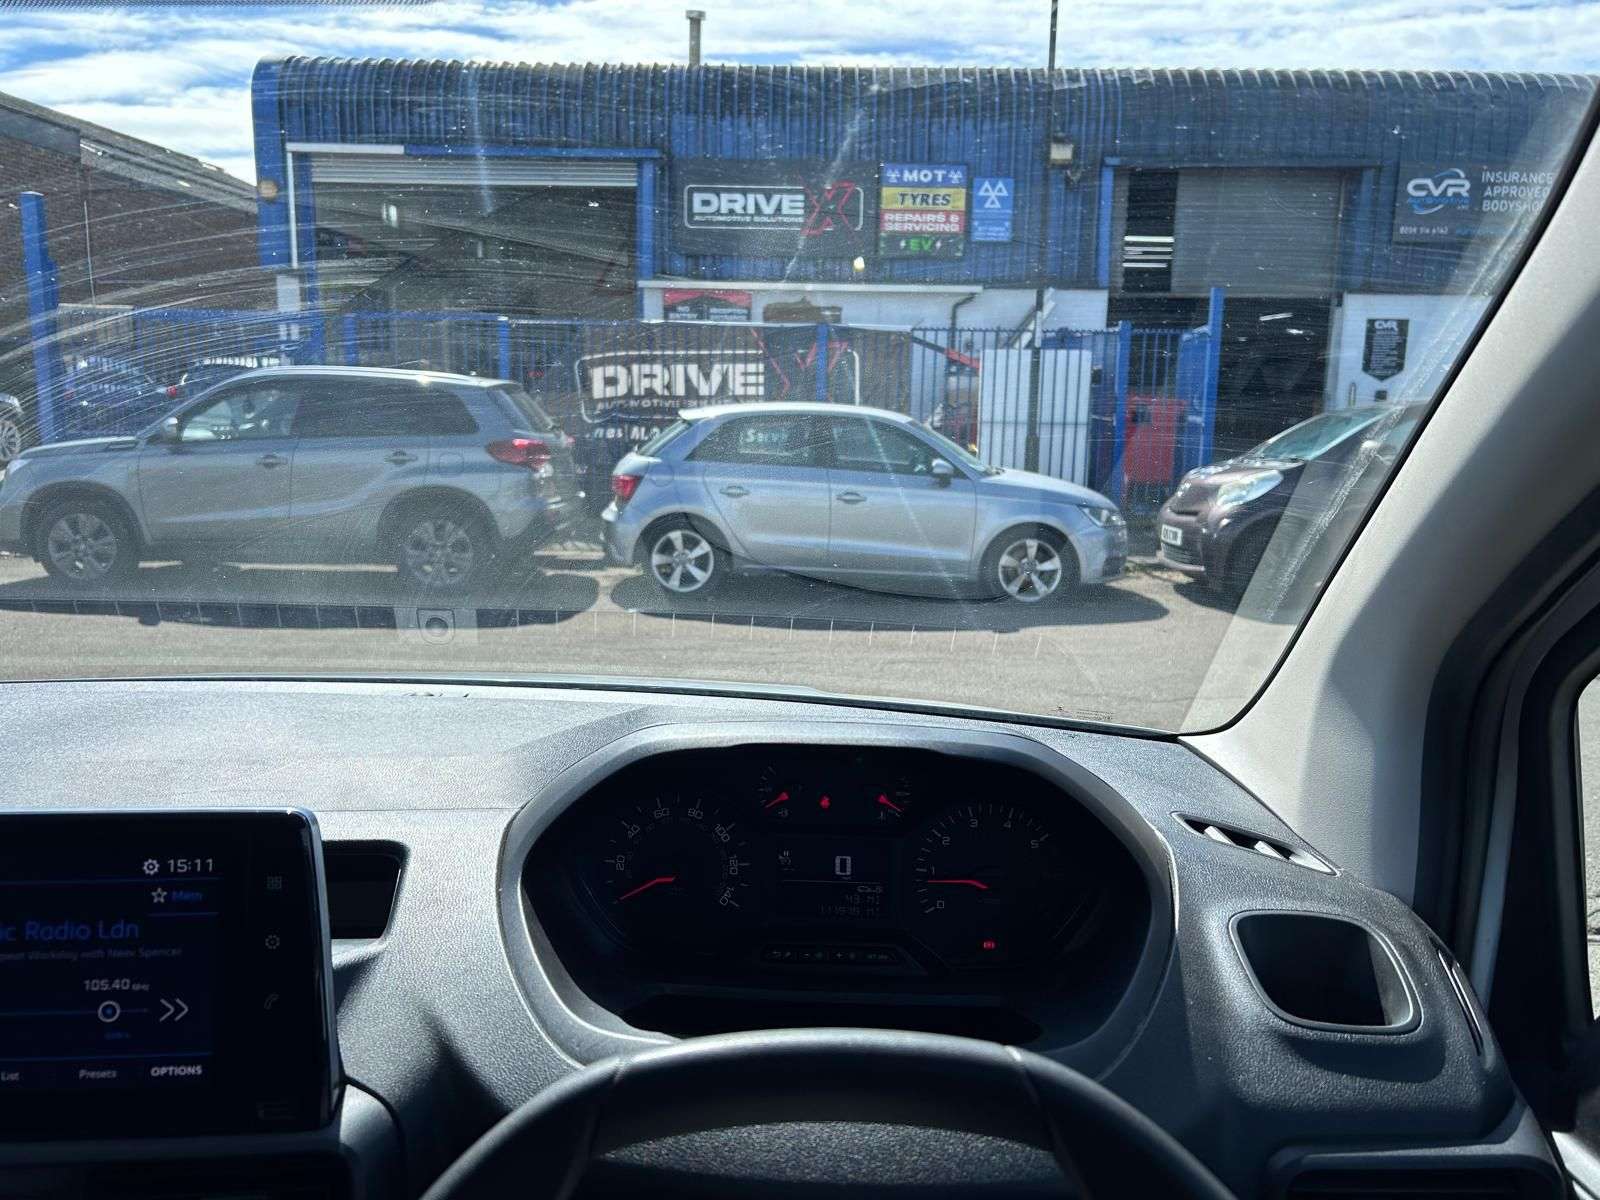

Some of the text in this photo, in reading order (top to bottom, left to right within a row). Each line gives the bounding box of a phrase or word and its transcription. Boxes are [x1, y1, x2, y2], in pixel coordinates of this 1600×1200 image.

[903, 169, 947, 183] MOT
[1482, 171, 1553, 184] INSURANCE
[1406, 178, 1471, 197] CVR
[693, 193, 805, 215] DRIVE
[899, 193, 952, 206] TYRES
[884, 213, 946, 223] REPAIRS
[884, 223, 961, 232] SERVICING
[910, 238, 934, 252] EV
[1374, 320, 1399, 331] CVR
[591, 363, 764, 400] DRIVE
[654, 807, 671, 818] 60
[688, 808, 703, 820] 80
[969, 818, 978, 828] 3
[1003, 818, 1012, 828] 4
[626, 824, 641, 840] 40
[712, 824, 730, 843] 100
[941, 836, 951, 846] 2
[167, 857, 214, 873] 15:11
[615, 854, 625, 871] 20
[728, 856, 739, 875] 120
[719, 888, 737, 906] 140
[24, 919, 92, 941] Radio
[97, 917, 140, 940] Ldn
[83, 978, 131, 991] 105.40
[78, 1067, 117, 1081] Presets
[150, 1064, 203, 1077] OPTIONS
